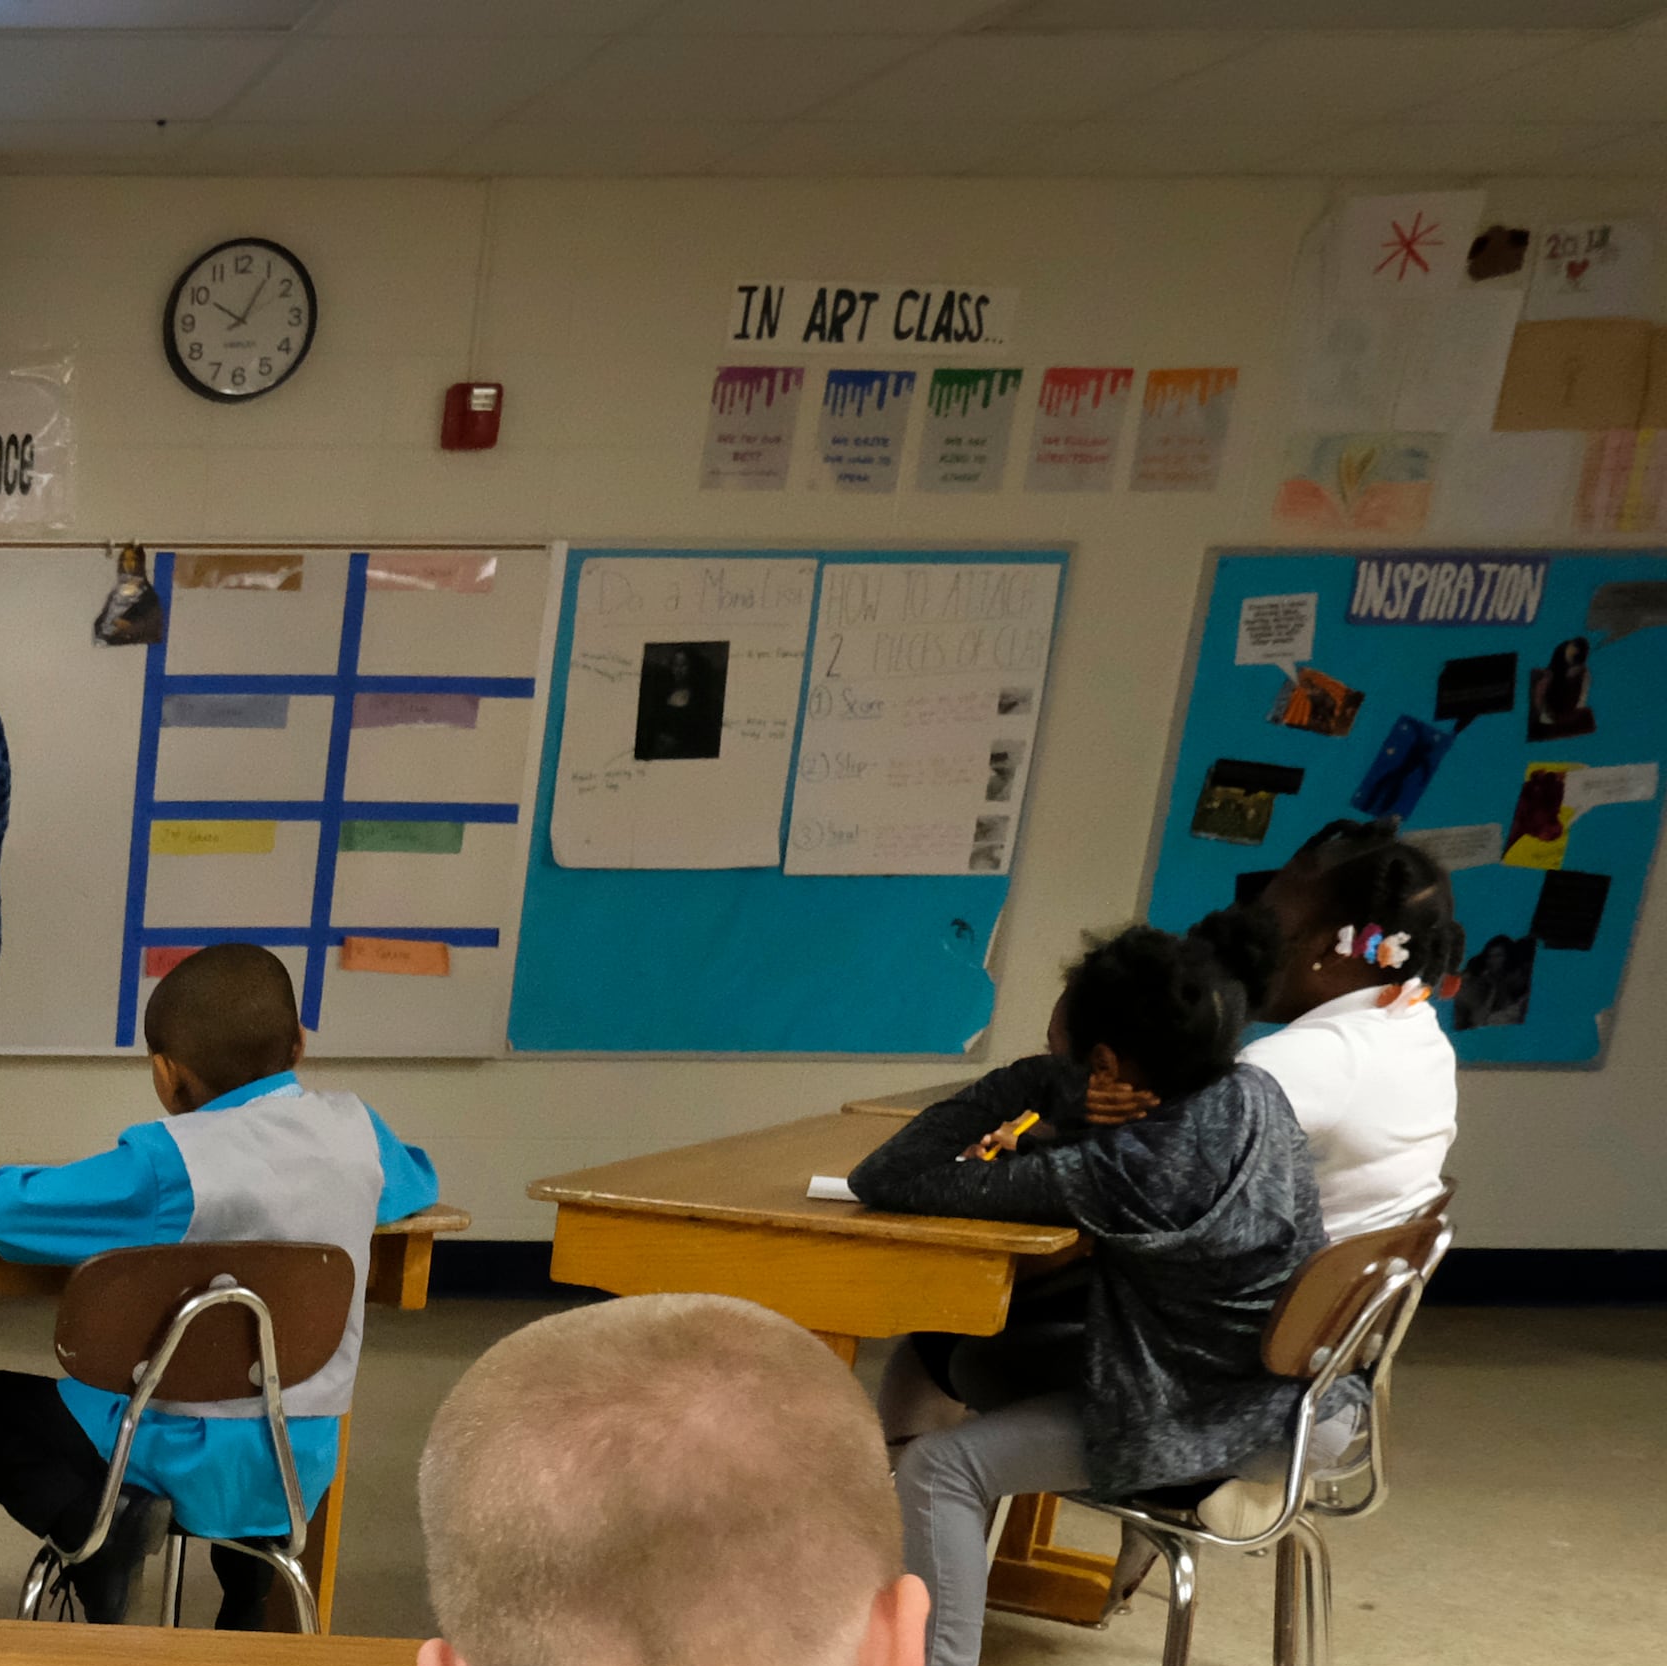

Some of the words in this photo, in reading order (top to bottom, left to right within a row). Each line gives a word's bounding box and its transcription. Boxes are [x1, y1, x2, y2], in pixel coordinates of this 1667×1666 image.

[212, 263, 224, 283] 11
[234, 254, 253, 274] 12
[266, 261, 272, 279] 1
[190, 286, 210, 306] 10
[278, 278, 293, 298] 2
[181, 313, 196, 333] 9
[287, 306, 303, 327] 3
[734, 285, 784, 340] IN
[802, 287, 880, 343] ART
[188, 342, 203, 361] 8
[277, 336, 292, 355] 4
[208, 362, 223, 381] 7
[231, 366, 246, 386] 6
[258, 356, 272, 376] 5
[1351, 560, 1546, 624] INSPIRATION
[826, 632, 844, 678] 2
